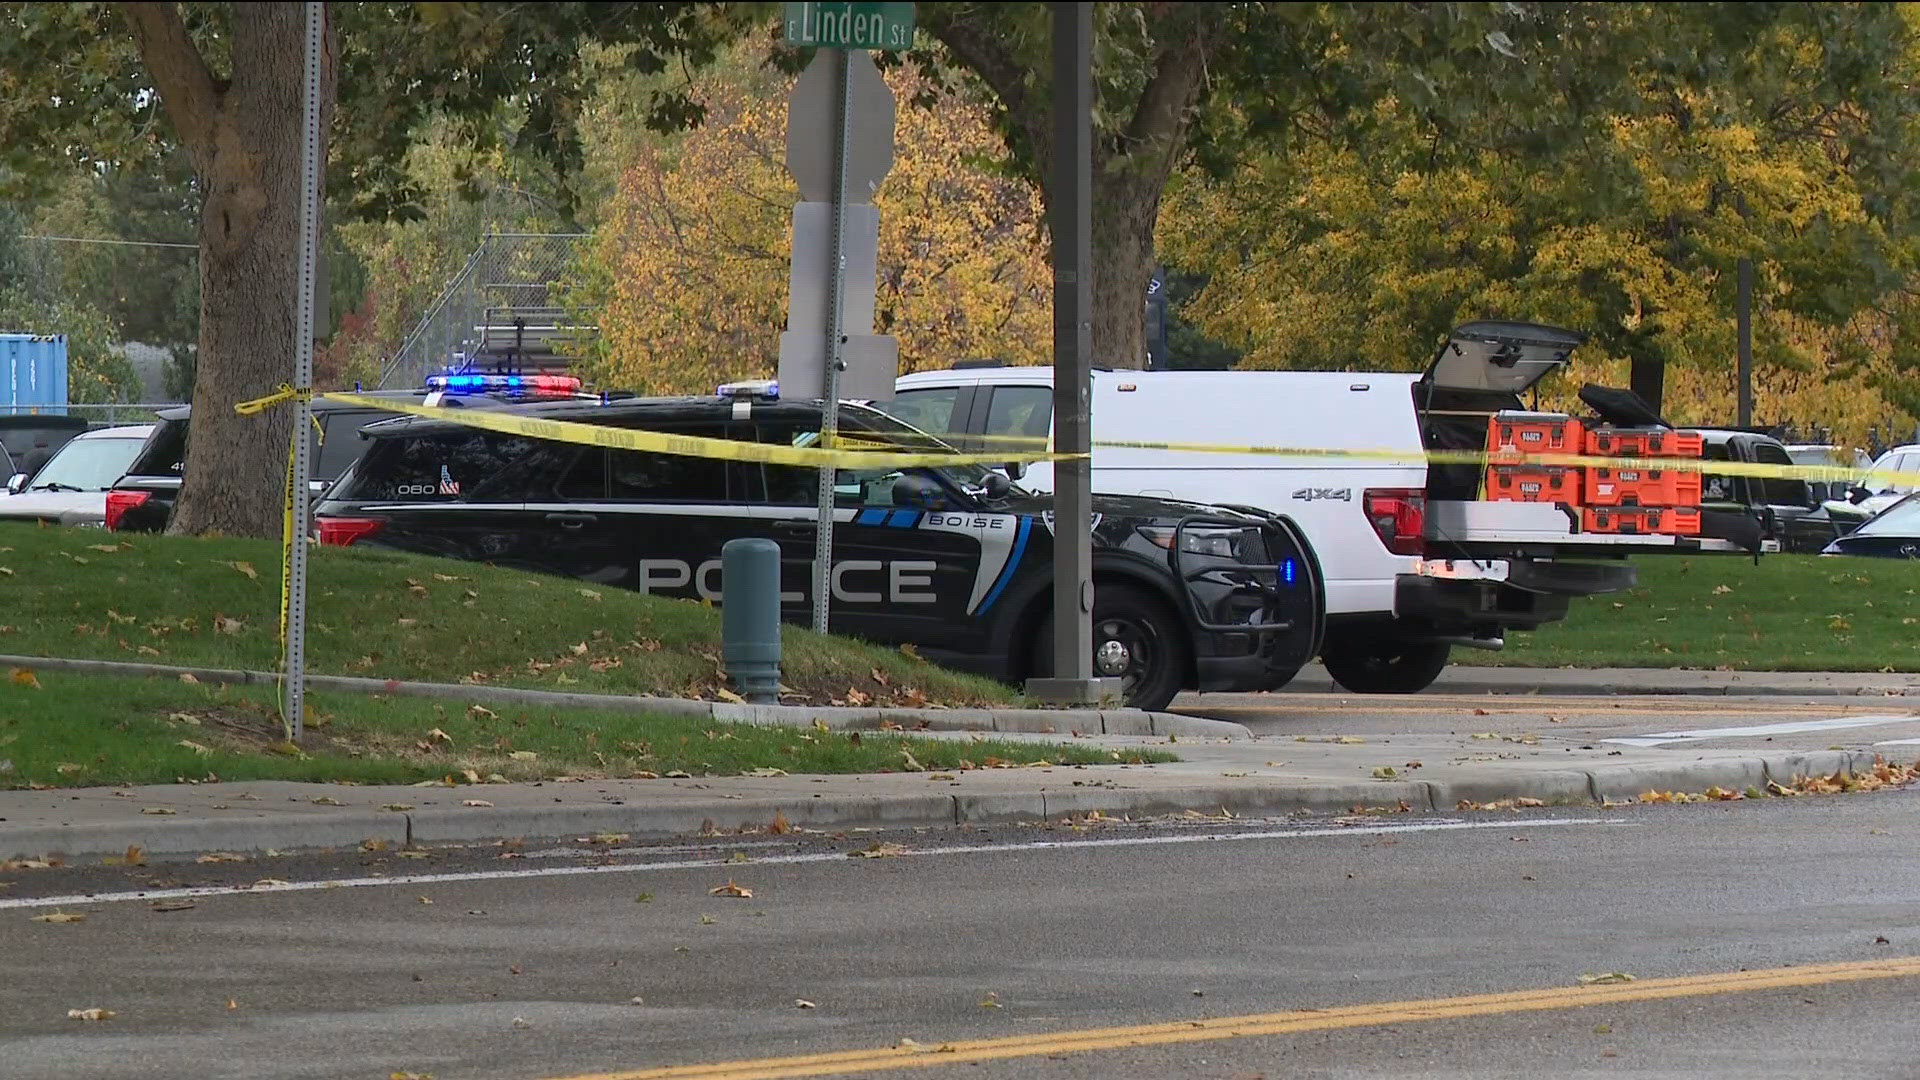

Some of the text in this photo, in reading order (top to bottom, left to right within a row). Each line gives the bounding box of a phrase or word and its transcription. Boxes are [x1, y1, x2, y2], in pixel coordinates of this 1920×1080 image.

[788, 2, 906, 45] E Linden St
[929, 515, 1004, 529] BOISE
[639, 559, 937, 602] POCE
